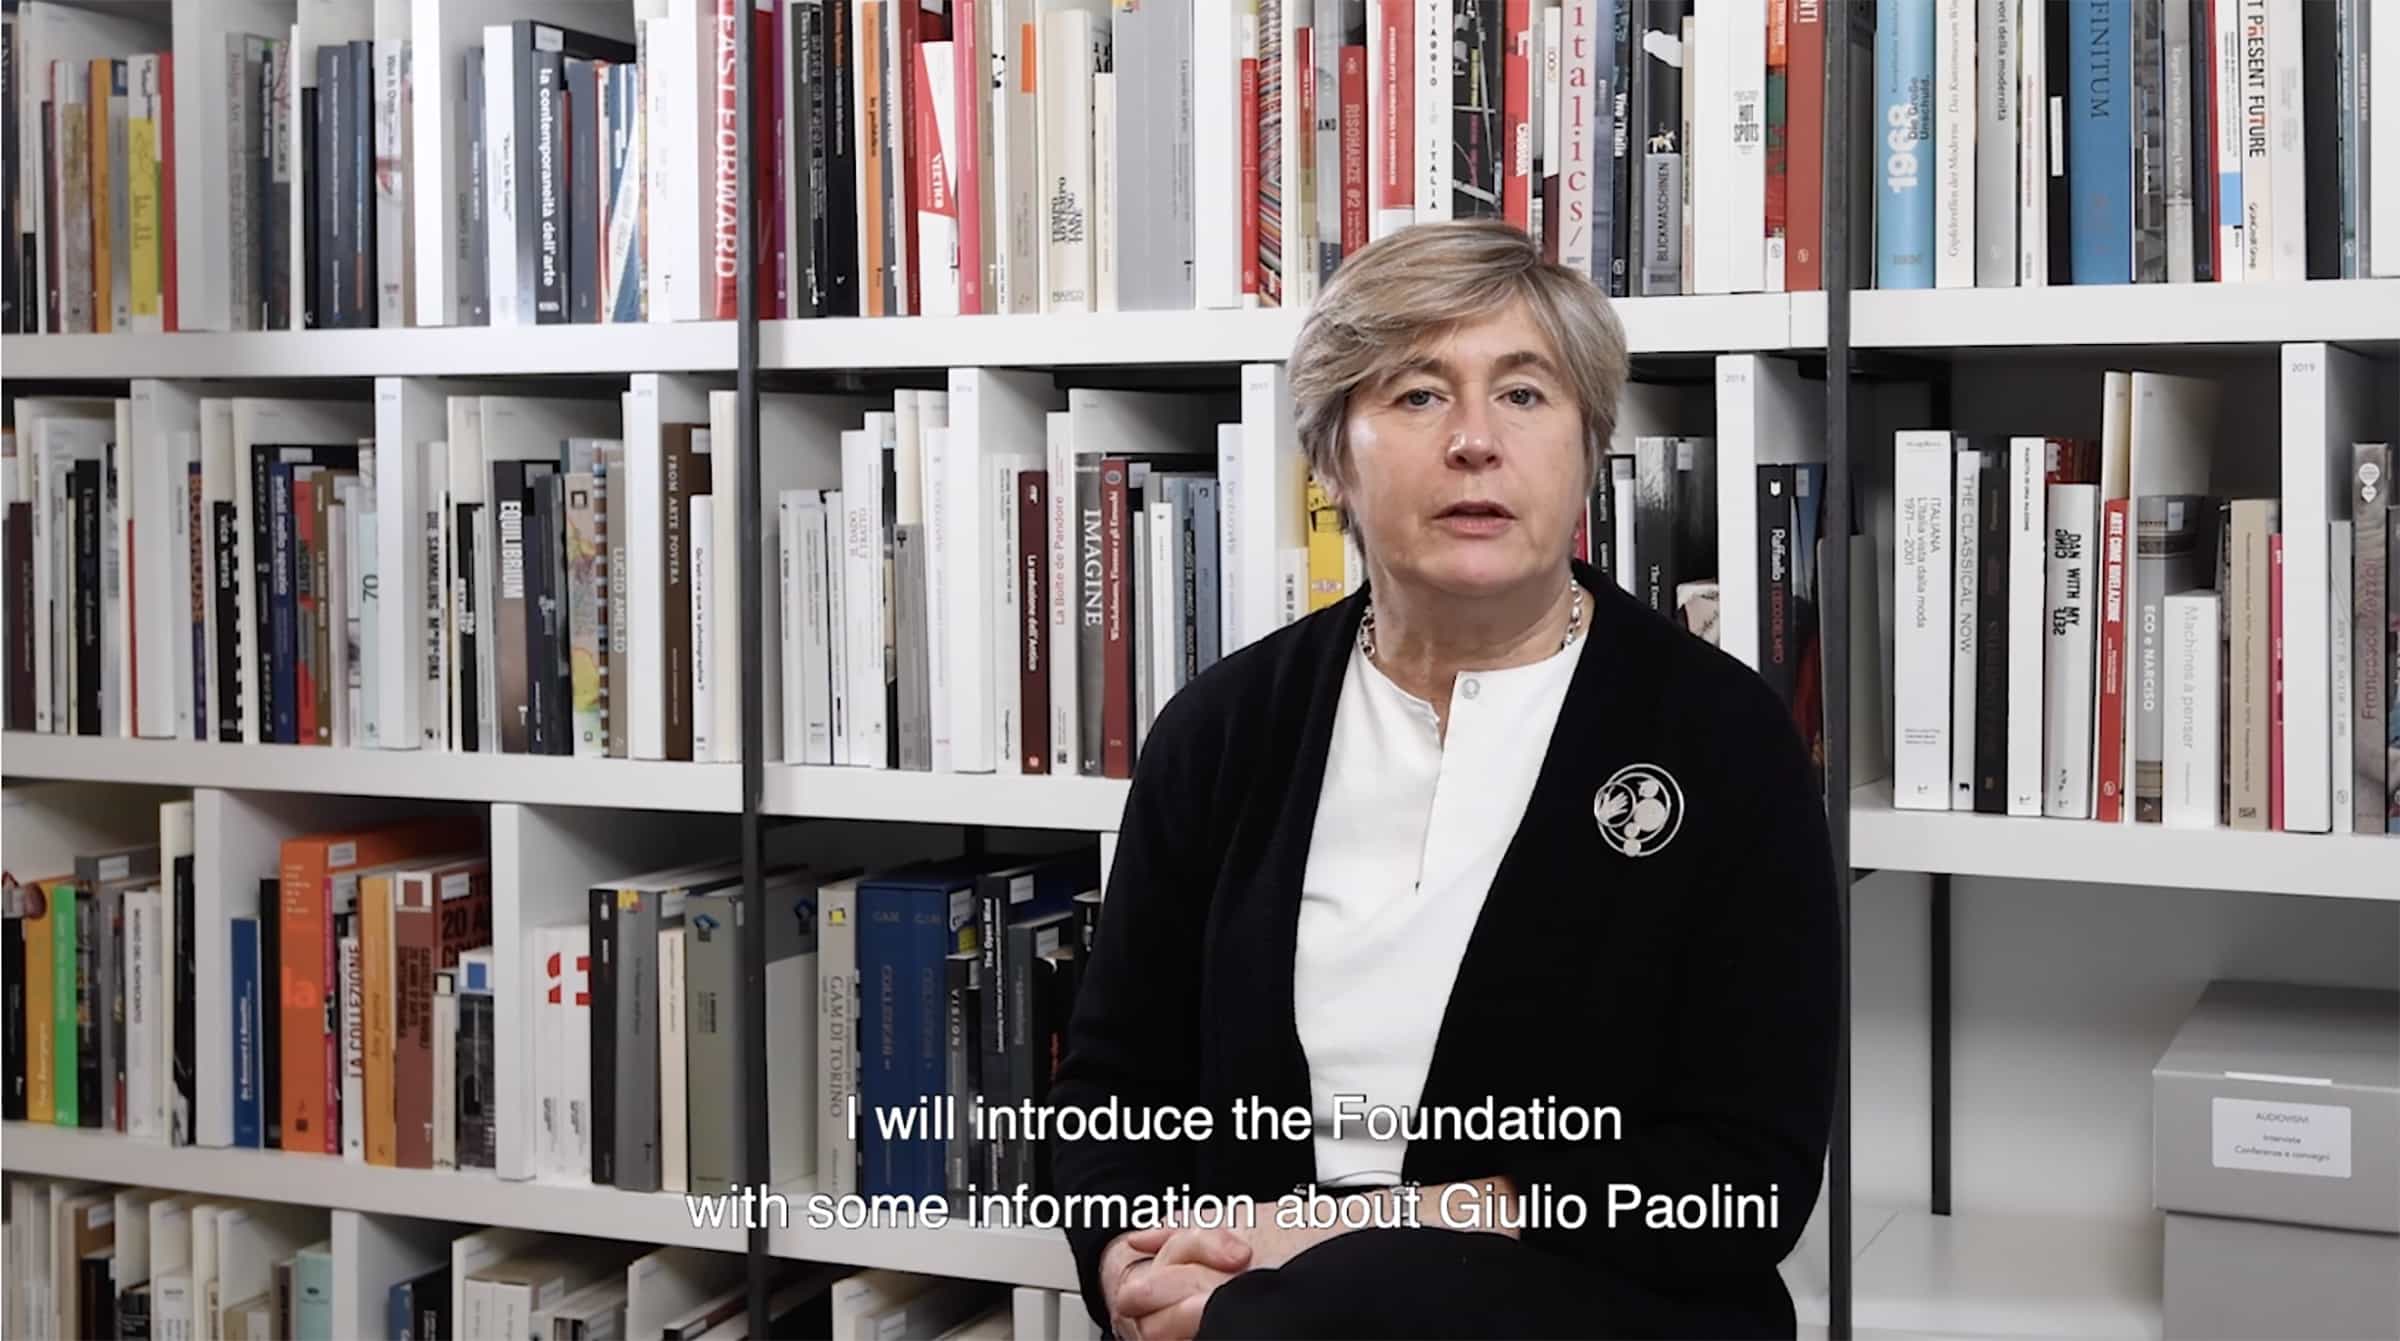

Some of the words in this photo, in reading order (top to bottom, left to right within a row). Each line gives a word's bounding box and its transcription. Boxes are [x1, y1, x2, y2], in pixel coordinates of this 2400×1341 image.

[1429, 3, 1438, 87] VIAGGIO
[1998, 25, 2008, 57] della
[2089, 1, 2111, 120] FINITUM
[2247, 15, 2265, 89] PRESENT
[539, 67, 554, 85] la
[1997, 58, 2008, 121] modernità
[1614, 92, 1627, 118] Viva
[1738, 104, 1754, 122] HOT
[1918, 73, 1931, 141] Unschuld.
[1733, 123, 1759, 143] SPOTS
[1886, 103, 1919, 193] 1968
[1907, 123, 1919, 141] Die
[2248, 96, 2266, 158] FUTURE
[537, 88, 557, 219] contemporaneità
[1429, 139, 1438, 210] ITALIA
[715, 108, 737, 278] FORWARD
[1655, 162, 1671, 263] BLICKMASCHINEN
[541, 221, 558, 287] dell'arte
[2291, 362, 2316, 374] 2019
[667, 454, 679, 492] FROM
[1960, 474, 1975, 507] THE
[667, 496, 680, 530] ARTE
[1054, 496, 1065, 549] Pandore
[1929, 496, 1942, 553] ITALIANA
[501, 501, 524, 599] EQUILIBRIUM
[669, 534, 680, 586] POVERA
[1055, 553, 1065, 571] de
[1083, 508, 1104, 627] IMAGINE
[1771, 528, 1786, 581] Raffaello
[1904, 538, 1915, 567] 2001
[1917, 536, 1929, 563] vista
[1960, 512, 1975, 608] CLASSICAL
[2067, 533, 2082, 559] DAN
[219, 550, 231, 589] versa
[361, 573, 379, 604] 70
[613, 546, 625, 594] LUCIO
[1650, 564, 1661, 583] The
[1917, 565, 1929, 593] dalla
[2066, 567, 2081, 600] WITH
[613, 597, 626, 655] AMELIO
[1055, 610, 1066, 626] La
[1917, 595, 1929, 629] moda
[1959, 612, 1973, 655] NOW
[2065, 606, 2081, 626] MY
[2143, 604, 2156, 633] ECO
[2183, 606, 2199, 681] Machines
[2143, 649, 2156, 713] NARCISO
[2361, 626, 2380, 721] Francesco
[2179, 695, 2195, 749] penser
[441, 905, 466, 942] 20
[983, 898, 993, 922] Mind
[984, 923, 995, 949] Open
[984, 950, 993, 968] The
[347, 943, 363, 1052] COLLEZIONE
[829, 975, 844, 1018] GAM
[951, 987, 962, 1046] VISION
[829, 1022, 844, 1042] DI
[829, 1045, 844, 1118] TORINO
[2255, 1112, 2310, 1124] AUDIOVISIVI
